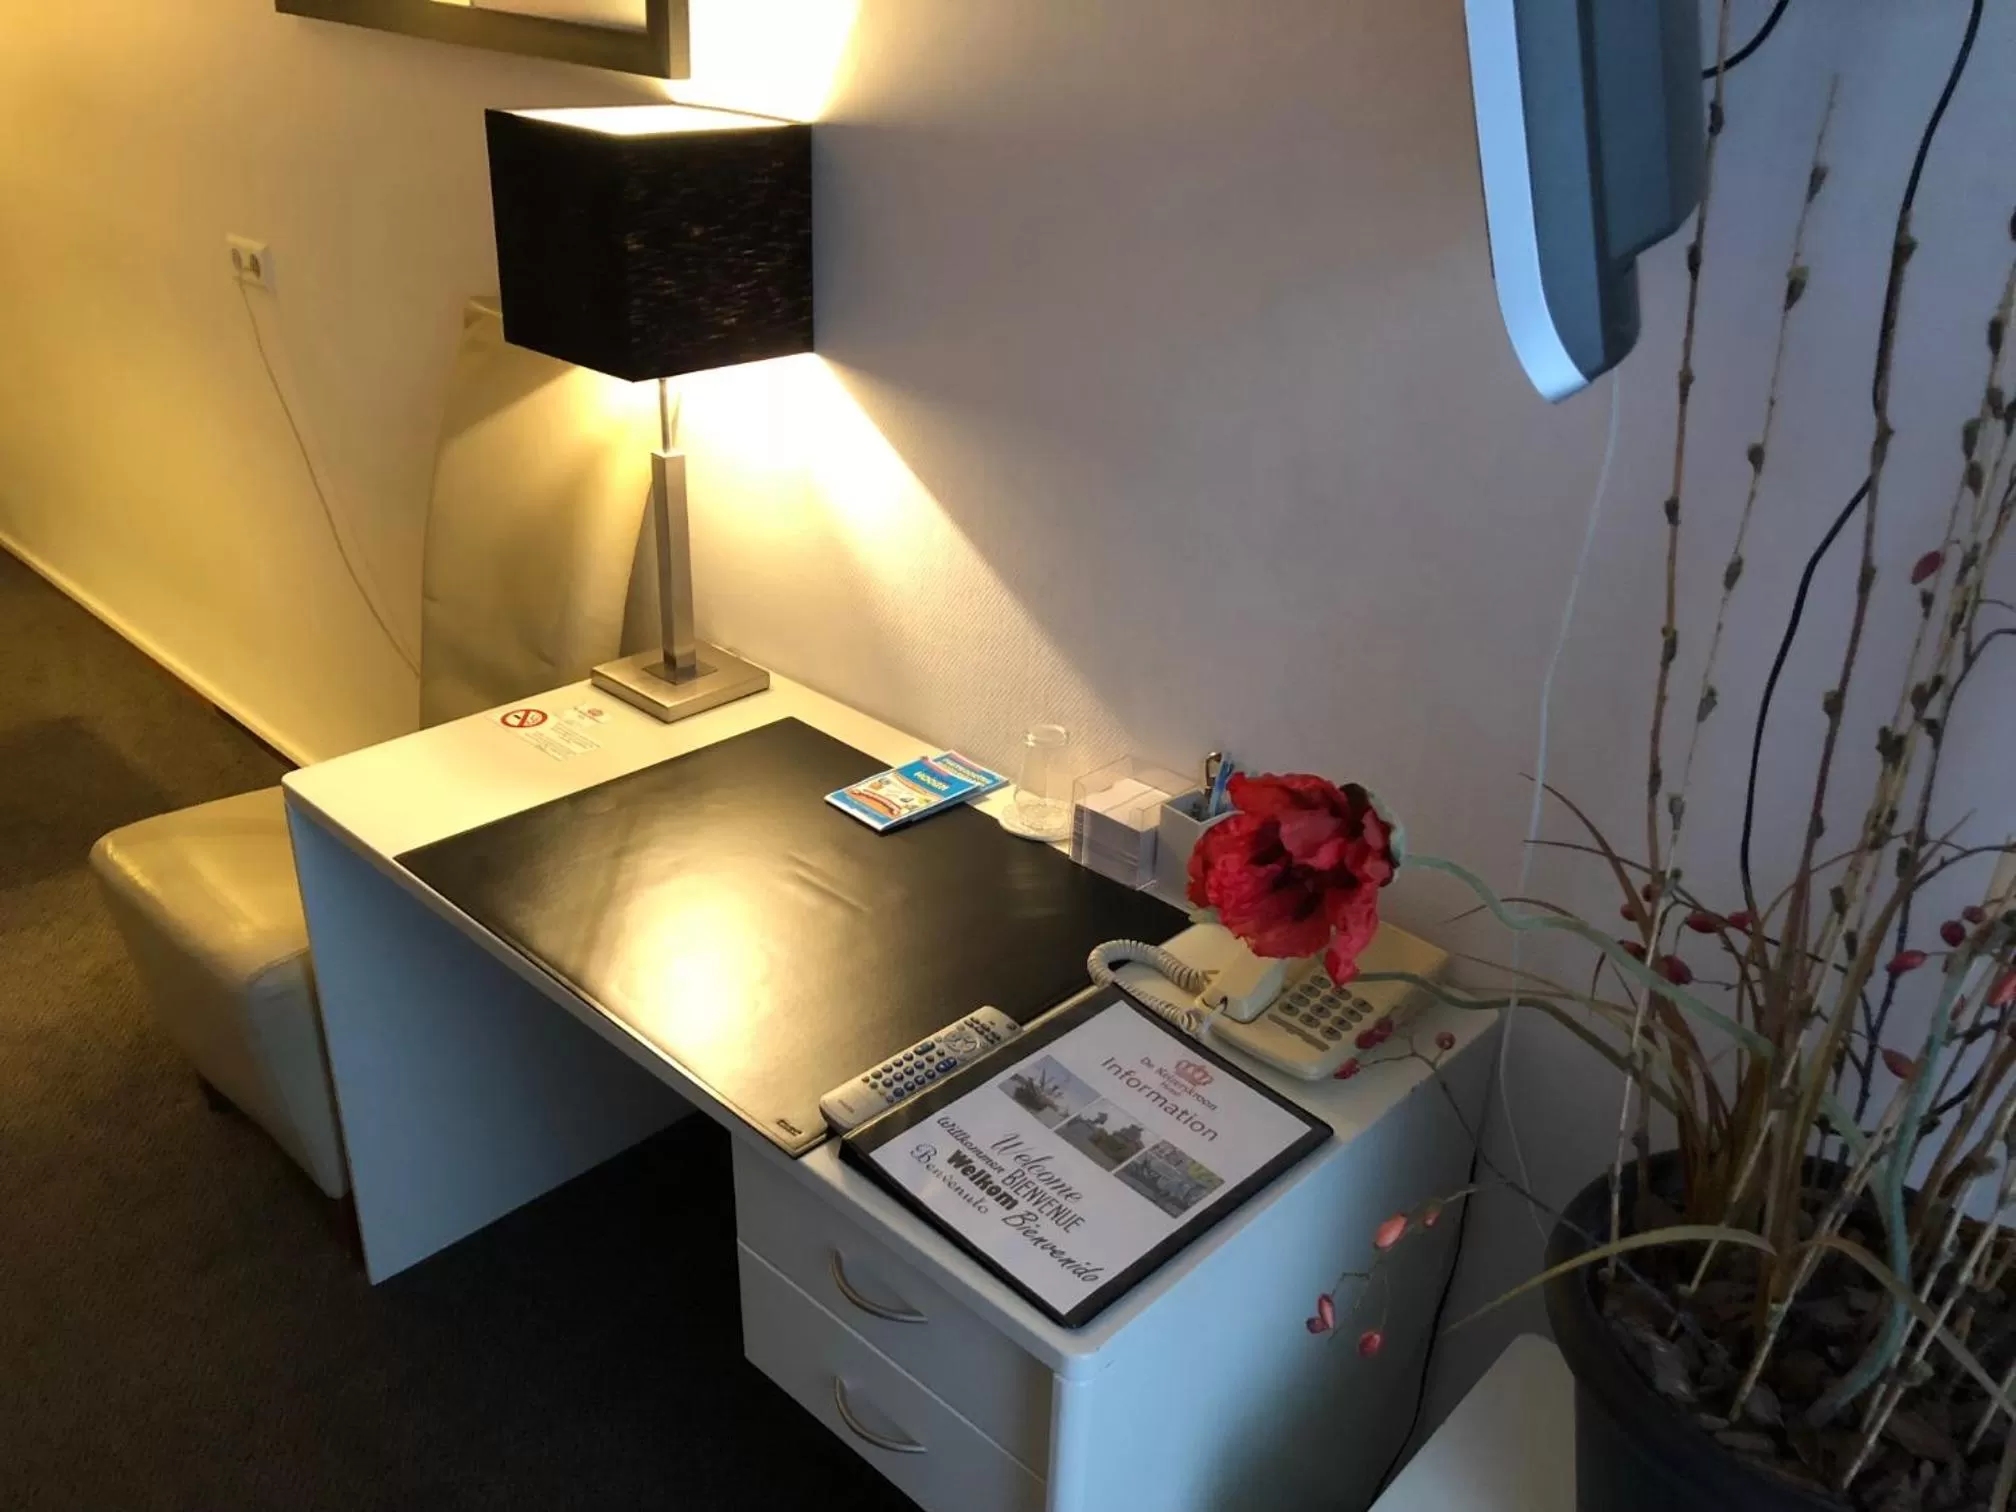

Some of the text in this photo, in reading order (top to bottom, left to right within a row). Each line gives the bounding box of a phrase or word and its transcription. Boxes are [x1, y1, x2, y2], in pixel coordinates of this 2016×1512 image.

[1140, 1056, 1155, 1069] De
[1100, 1056, 1218, 1142] Information
[910, 1143, 989, 1215] Benvenuto
[937, 1115, 1005, 1174] Willkommen
[990, 1130, 1083, 1204] Welcome
[946, 1149, 1020, 1211] Welkom
[1002, 1168, 1086, 1234] BIENVENUE
[1002, 1210, 1105, 1283] Bienvenido
